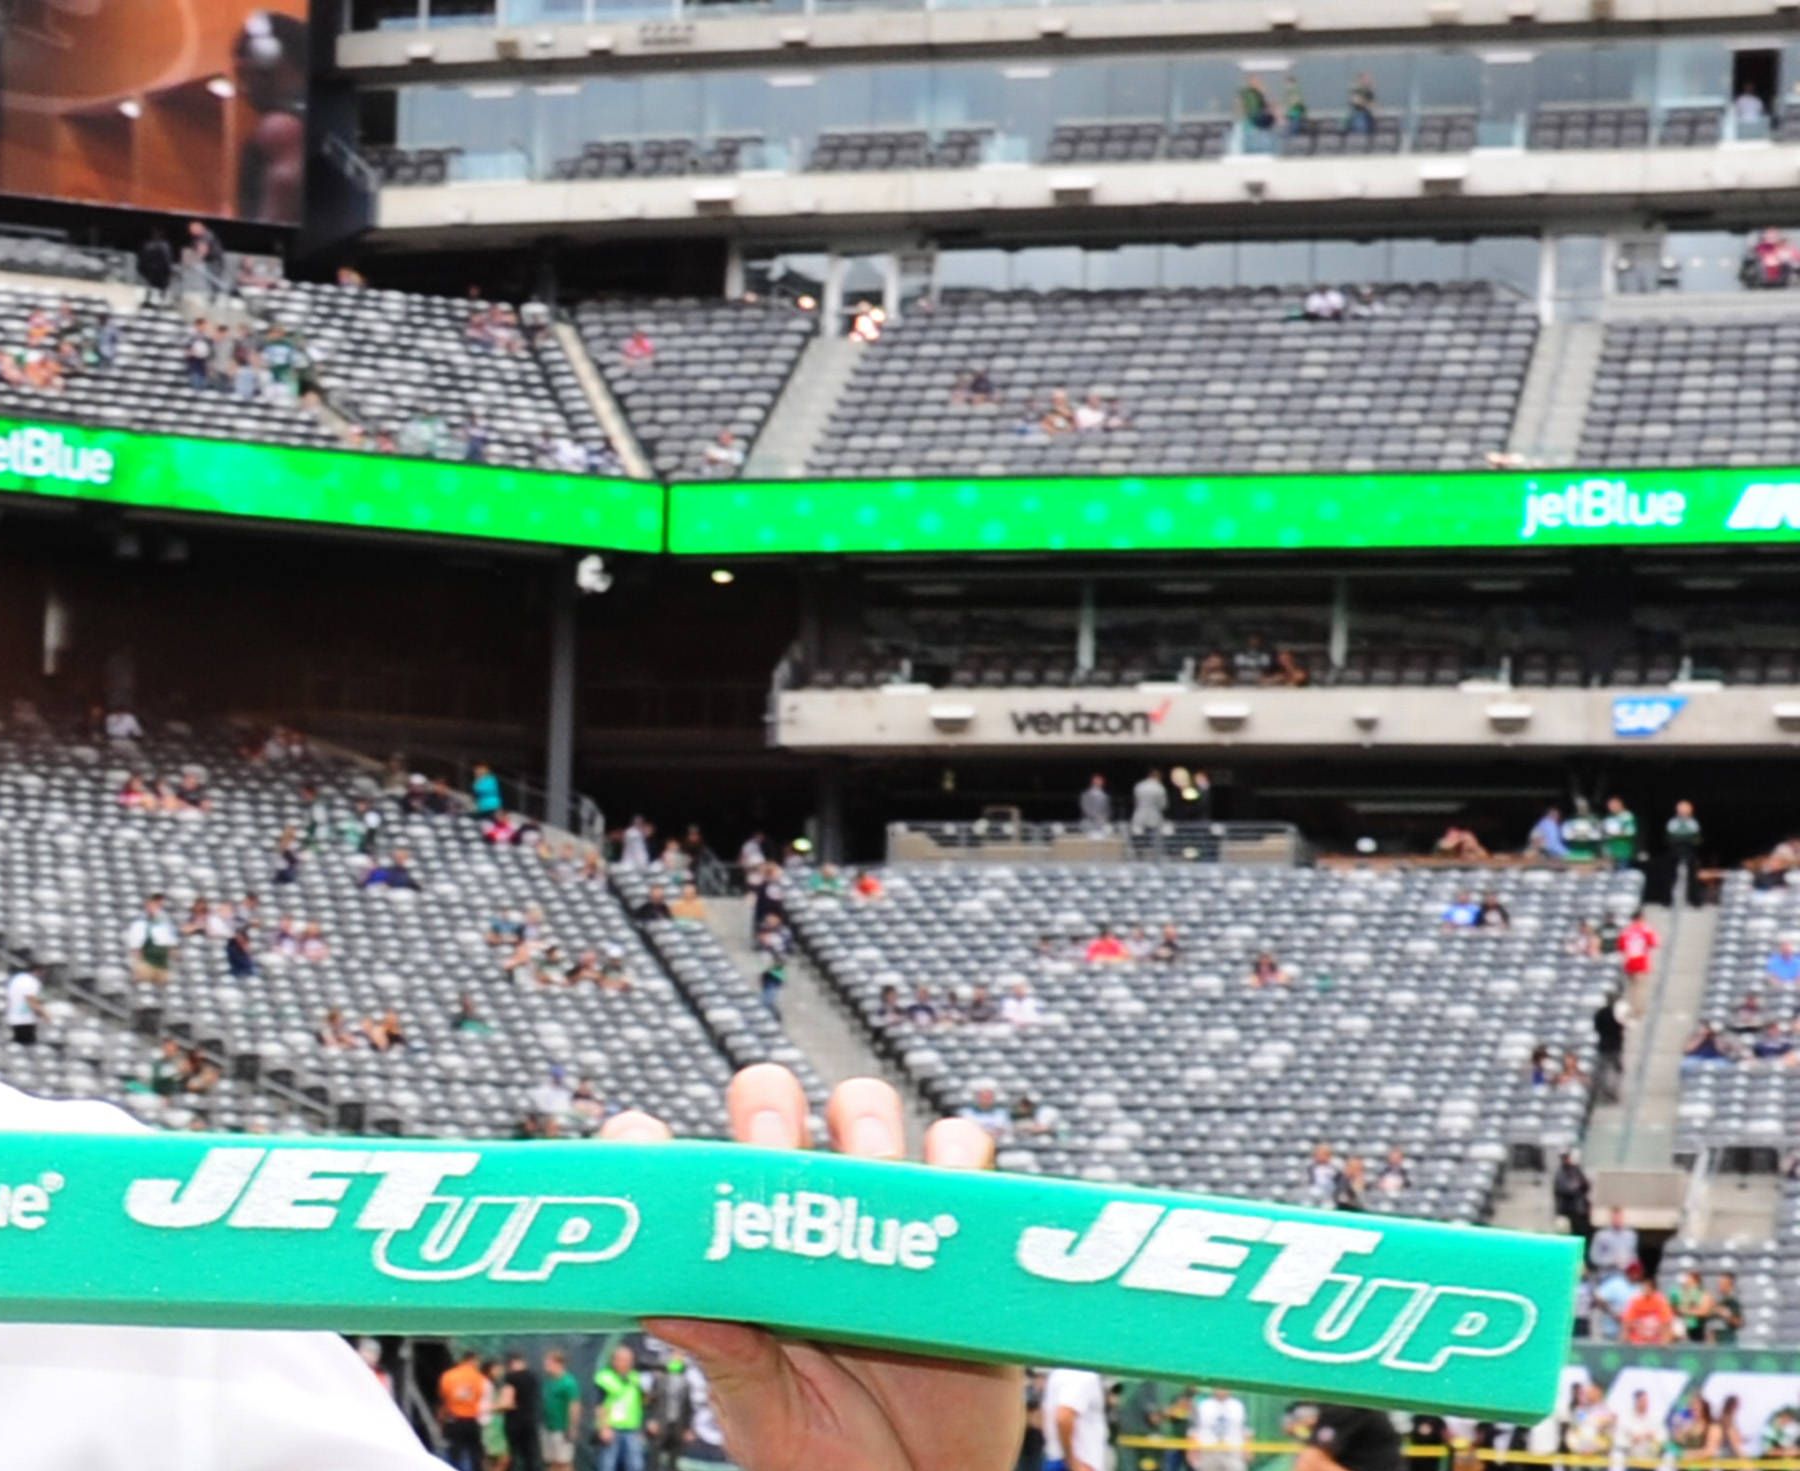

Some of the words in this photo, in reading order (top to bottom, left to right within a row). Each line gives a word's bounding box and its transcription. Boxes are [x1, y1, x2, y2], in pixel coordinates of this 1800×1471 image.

[1519, 480, 1687, 539] jetBlue
[1010, 702, 1151, 735] verizon
[1613, 701, 1673, 732] SAP
[123, 1146, 482, 1233] JET
[372, 1195, 641, 1284] UP
[1015, 1199, 1383, 1307] JET
[1263, 1274, 1539, 1373] UP
